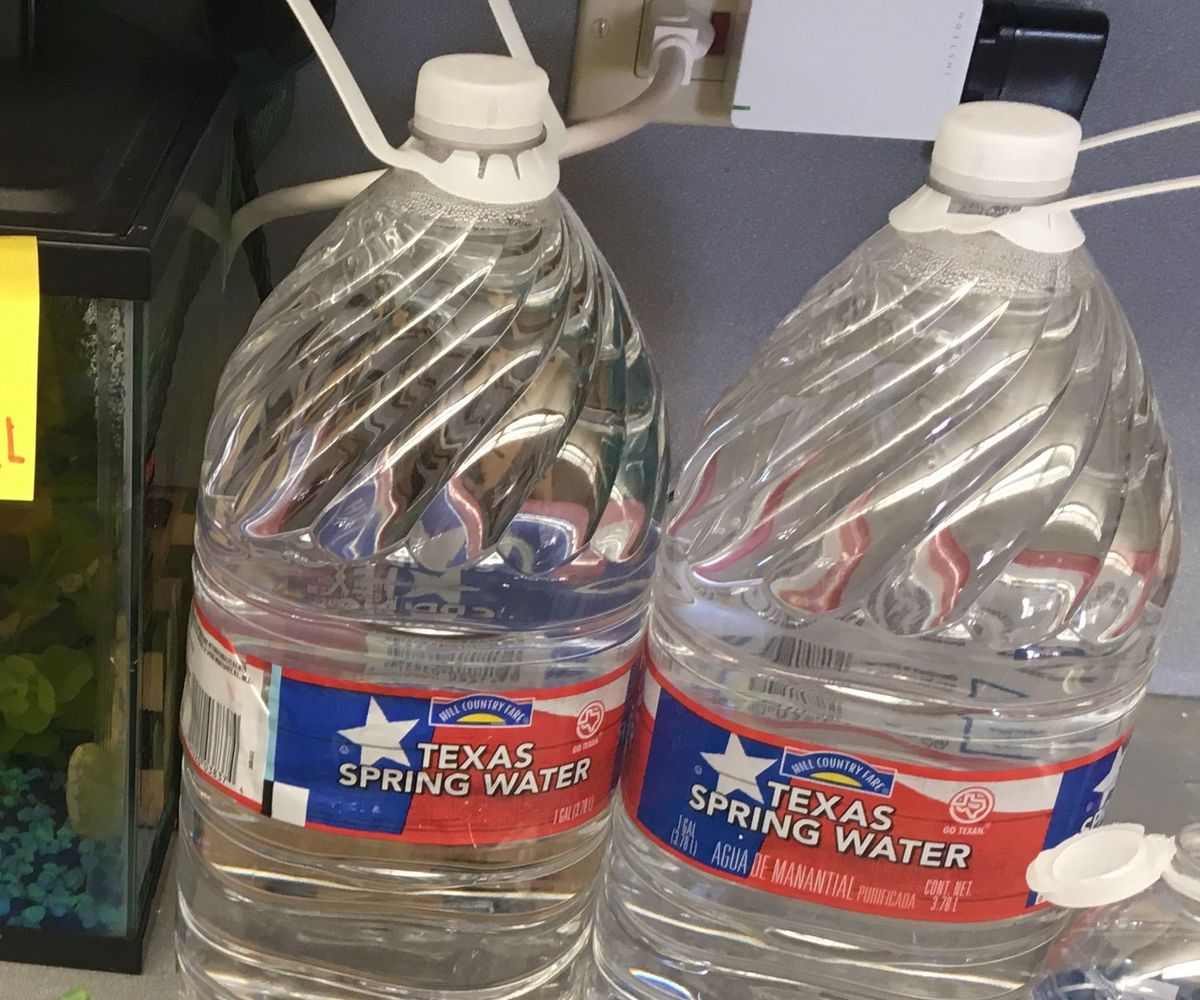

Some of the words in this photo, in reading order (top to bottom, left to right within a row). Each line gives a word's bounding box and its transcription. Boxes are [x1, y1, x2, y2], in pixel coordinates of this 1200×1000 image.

[439, 706, 461, 722] HILL
[461, 699, 503, 712] COUNTRY
[503, 703, 526, 723] FARE
[417, 742, 534, 770] TEXAS
[338, 763, 471, 797] SPRING
[484, 757, 592, 797] WATER
[791, 757, 815, 774] HILL
[816, 756, 861, 778] COUNTRY
[862, 770, 885, 790] FARE
[767, 781, 896, 831] TEXAS
[683, 817, 697, 836] GAL
[688, 783, 821, 847] SPRING
[835, 824, 973, 870] WATER
[943, 826, 956, 835] GO
[711, 840, 748, 875] AGUA
[750, 851, 771, 880] DE
[771, 858, 855, 900] MANANTIAL
[857, 884, 916, 910] PURIFICADA
[924, 879, 950, 897] CONT.
[952, 880, 973, 897] NET.
